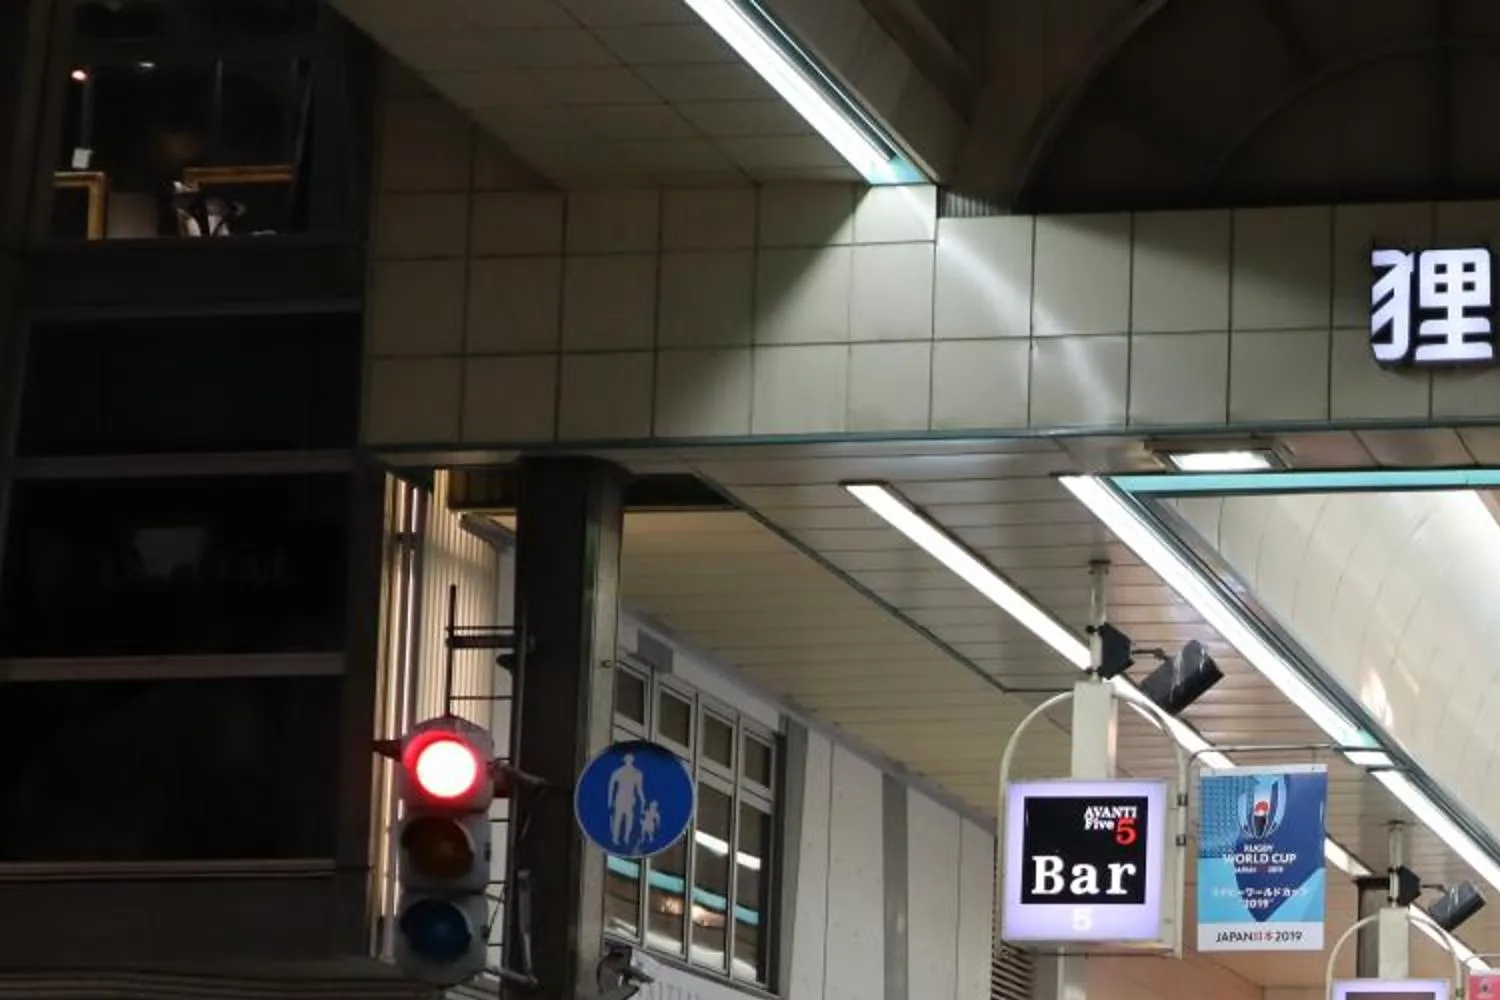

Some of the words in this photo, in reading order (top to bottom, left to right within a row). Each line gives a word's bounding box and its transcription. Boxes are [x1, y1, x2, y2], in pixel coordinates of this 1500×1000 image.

[1084, 806, 1137, 819] AVANTI
[1084, 819, 1114, 831] Five
[1116, 819, 1137, 845] 5
[1223, 854, 1269, 864] WORLD
[1271, 854, 1297, 864] CUP
[1031, 856, 1136, 895] Bar
